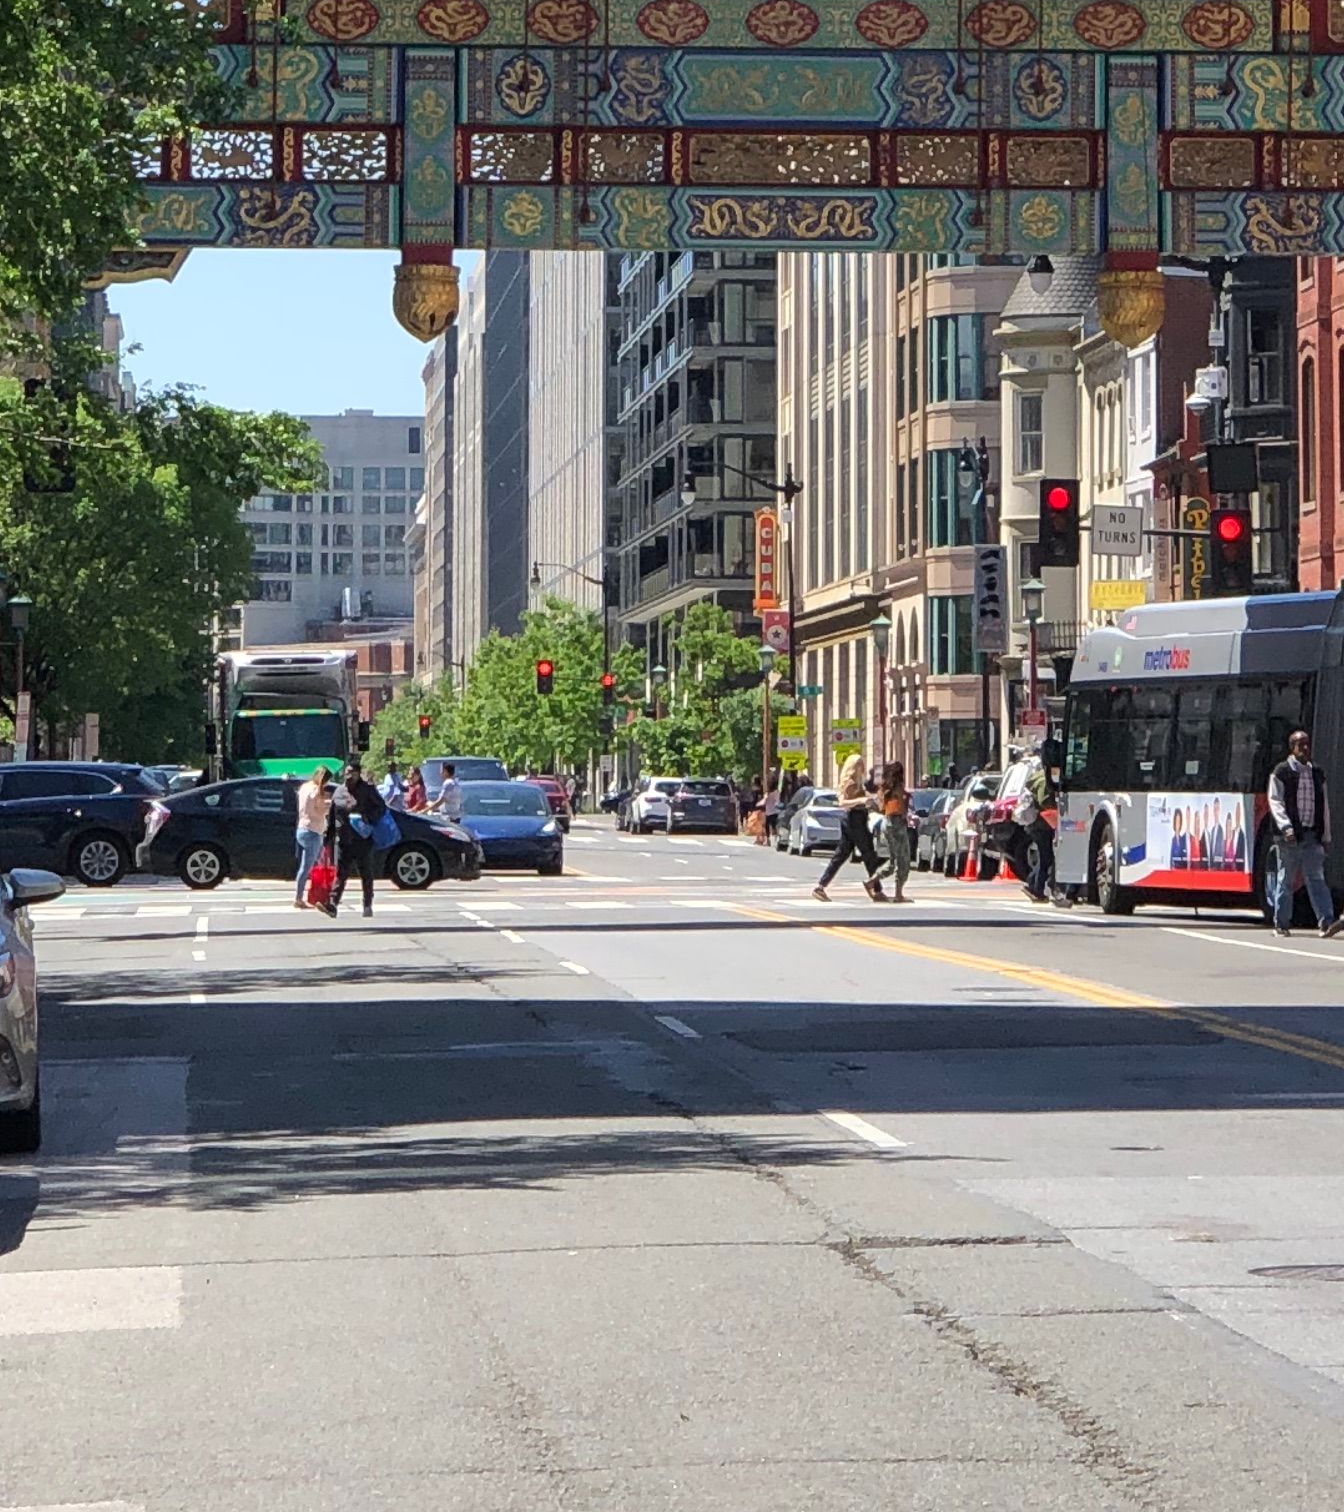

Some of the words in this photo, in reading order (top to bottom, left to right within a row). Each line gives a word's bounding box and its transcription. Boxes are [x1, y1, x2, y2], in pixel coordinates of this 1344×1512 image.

[1109, 512, 1126, 524] NO
[1098, 530, 1136, 545] TURNS
[760, 526, 774, 592] CUBA
[1143, 642, 1191, 671] metrobus
